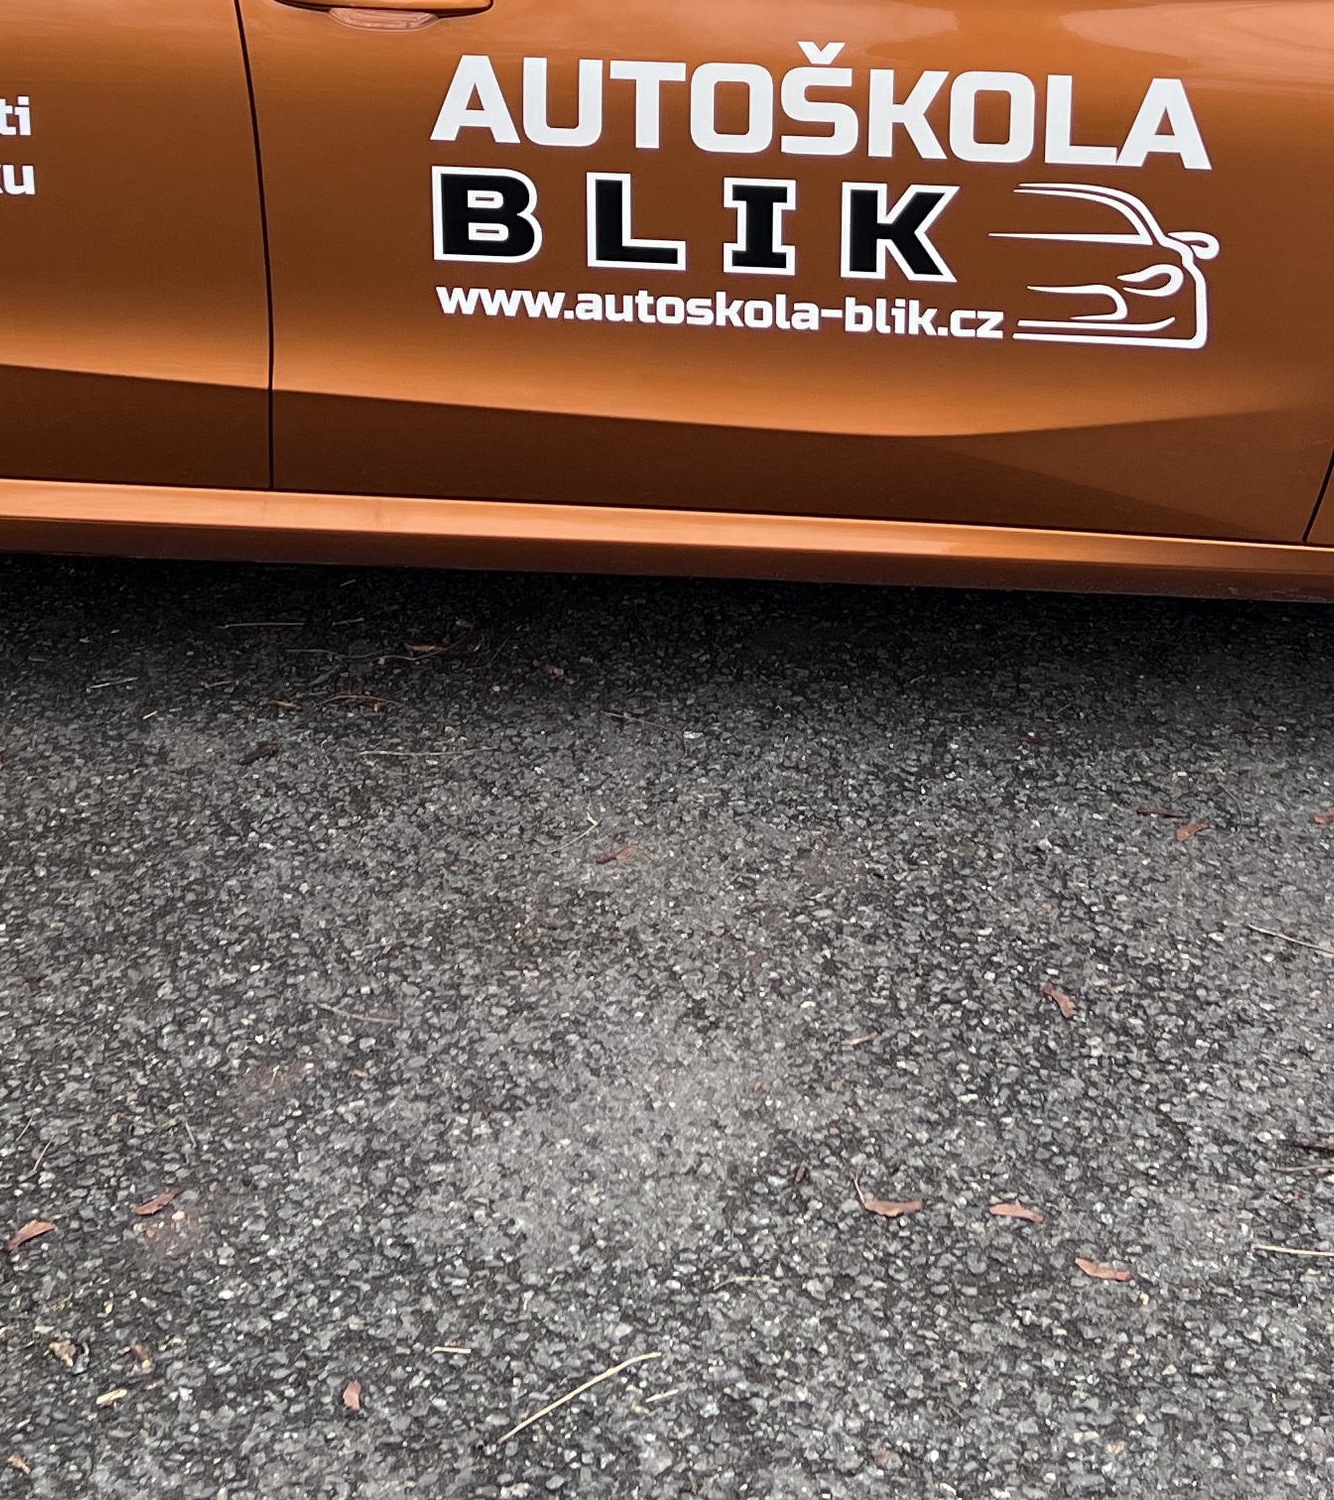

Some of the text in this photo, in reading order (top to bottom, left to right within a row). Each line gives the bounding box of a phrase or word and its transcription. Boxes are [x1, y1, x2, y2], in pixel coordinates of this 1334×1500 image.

[430, 41, 1212, 171] AUTOŠKOLA
[432, 165, 960, 283] BLIK
[436, 286, 1005, 340] www.autoskola-blik.cz
